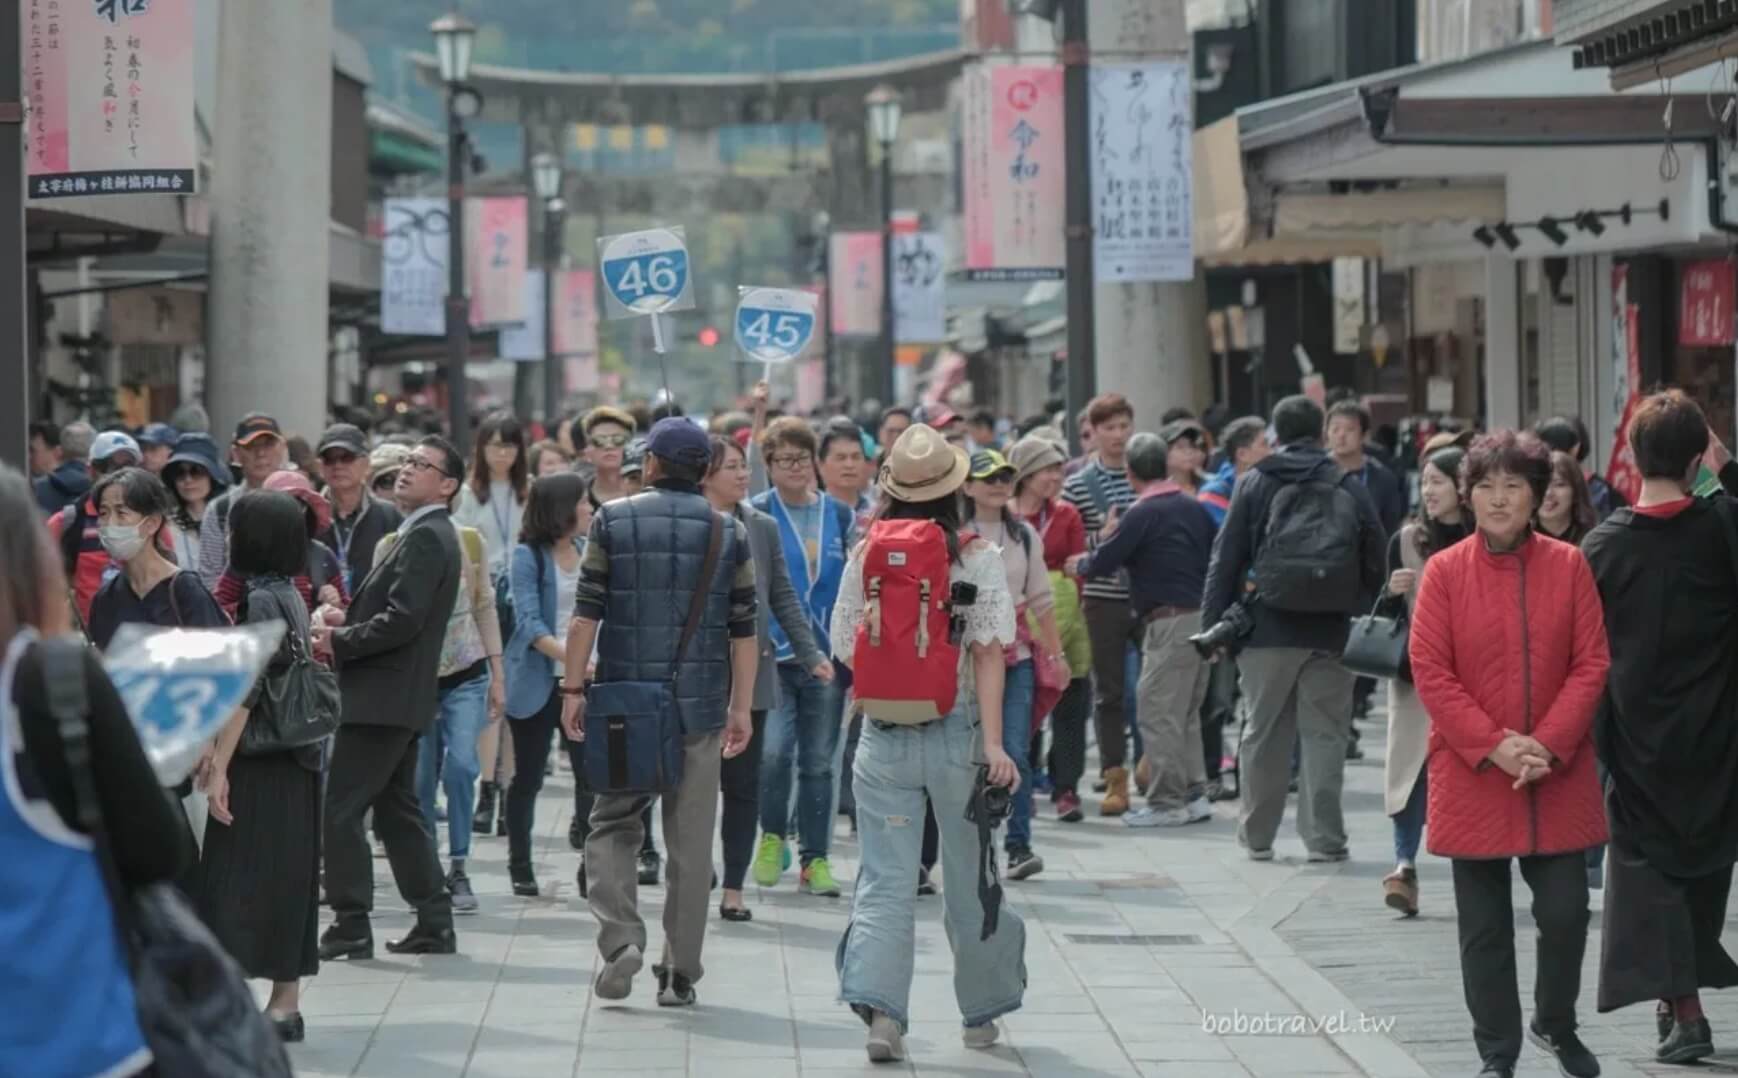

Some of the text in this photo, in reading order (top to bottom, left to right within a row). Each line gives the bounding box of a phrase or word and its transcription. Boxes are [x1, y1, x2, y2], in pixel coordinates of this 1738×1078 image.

[1008, 119, 1040, 183] 令和
[617, 256, 678, 296] 46
[745, 312, 801, 347] 45
